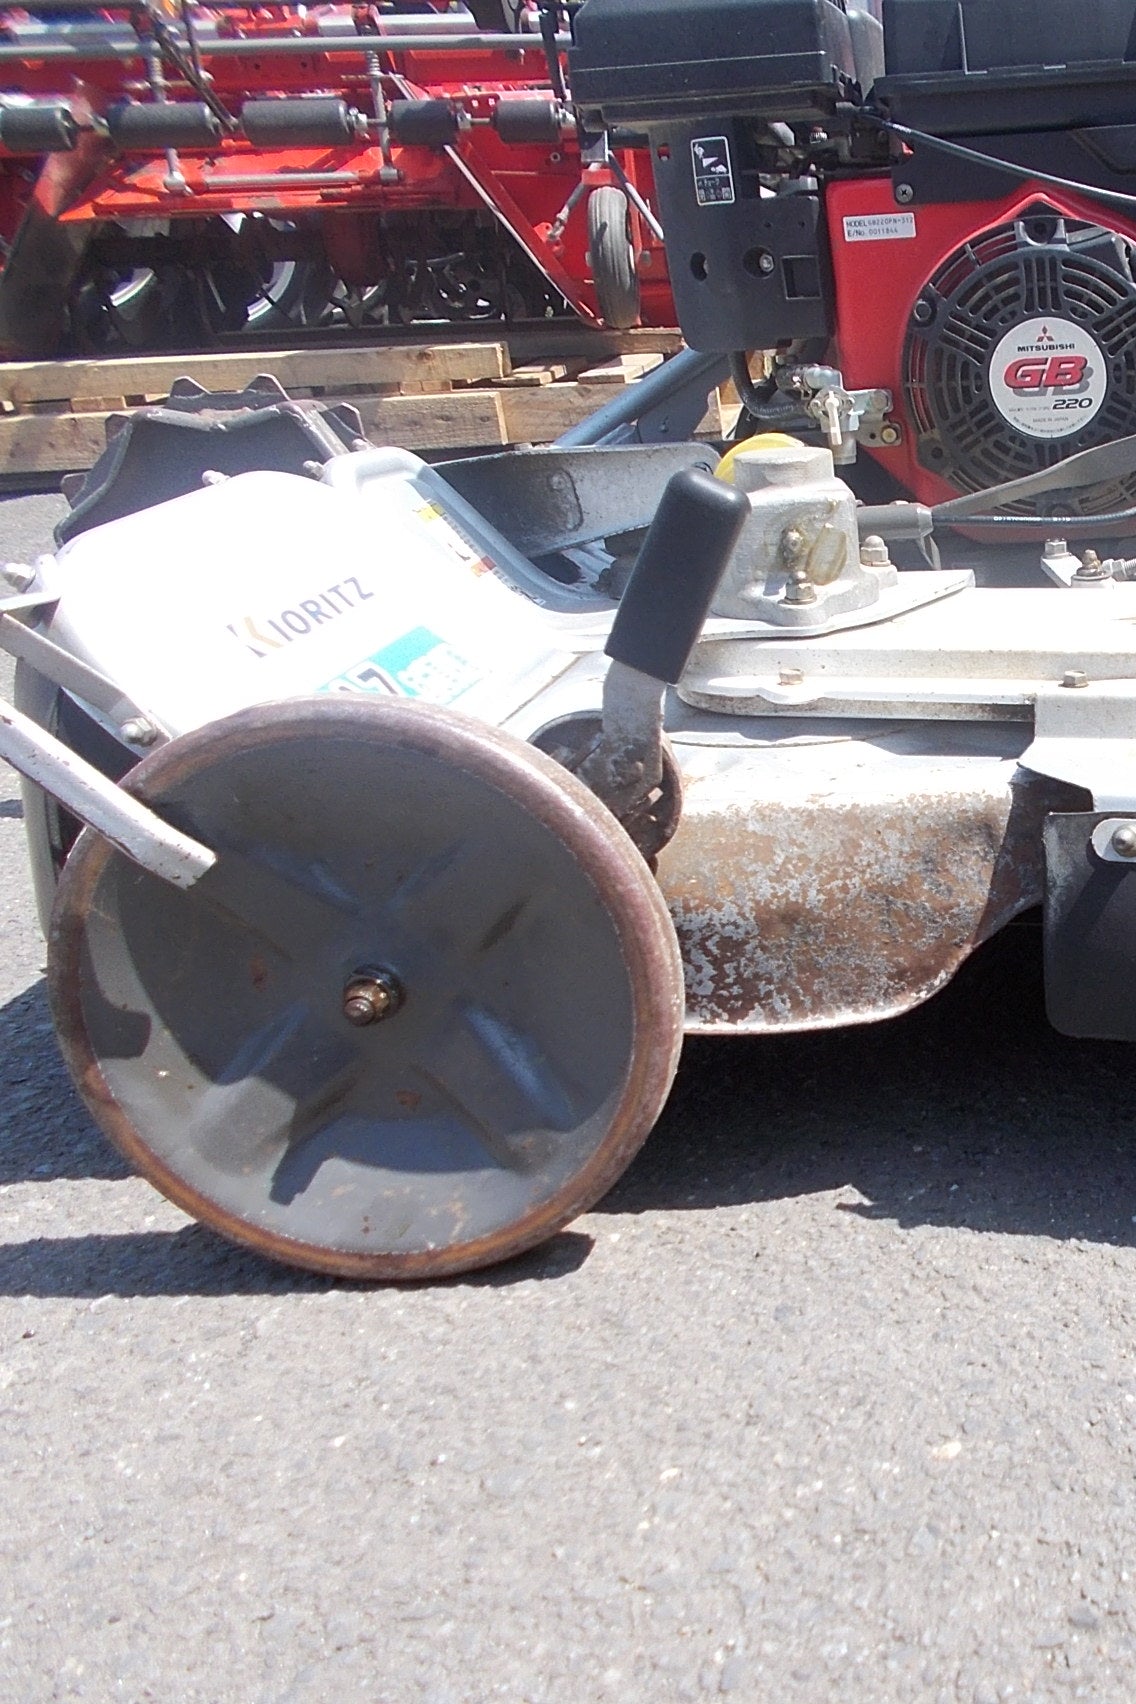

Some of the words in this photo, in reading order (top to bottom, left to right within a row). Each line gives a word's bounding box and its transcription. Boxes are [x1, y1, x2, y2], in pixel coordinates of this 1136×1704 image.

[846, 219, 868, 228] MODEL
[1017, 343, 1075, 352] MITSUBISHI
[1003, 355, 1088, 389] GB
[1052, 398, 1093, 410] 220
[226, 576, 375, 658] KIORITZ
